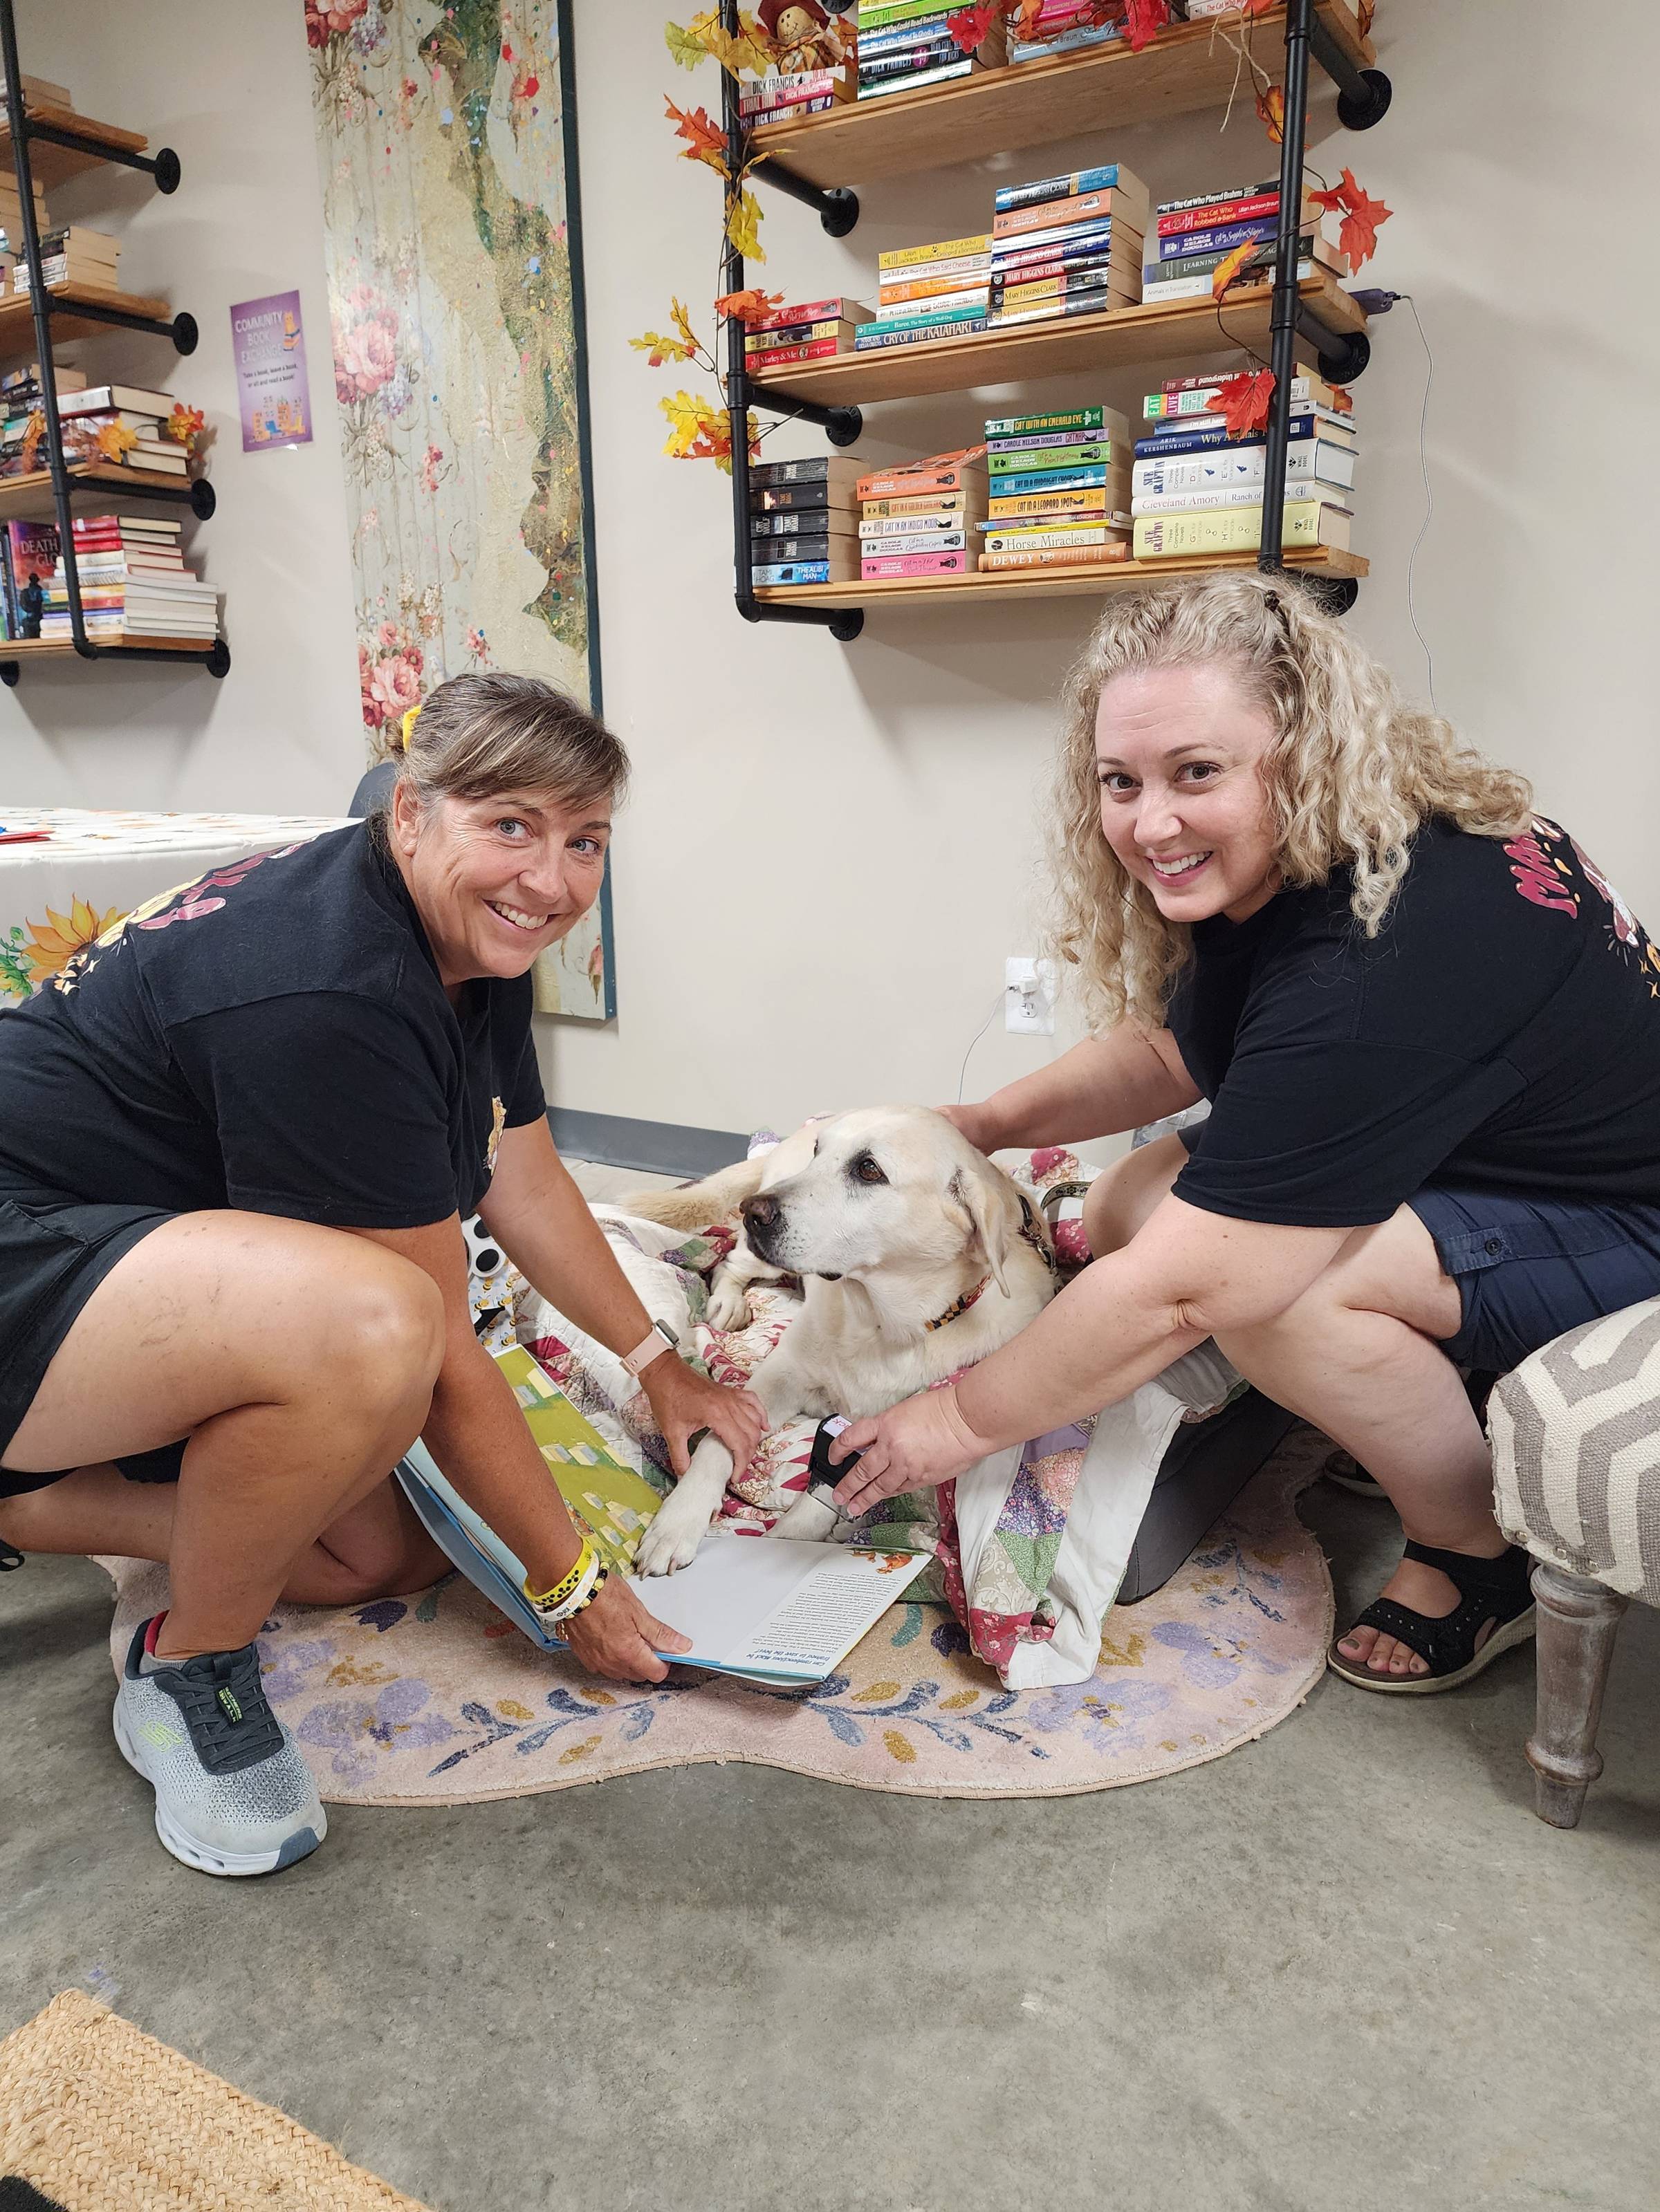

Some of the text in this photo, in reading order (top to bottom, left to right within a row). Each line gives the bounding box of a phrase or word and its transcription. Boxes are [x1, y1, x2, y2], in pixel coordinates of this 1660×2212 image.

[753, 79, 767, 94] DICK
[768, 75, 795, 92] FRANCIS
[743, 95, 761, 113] TRIAL
[755, 108, 793, 127] DICK FRANCIS
[1174, 188, 1243, 210] The Cat Who Played Brahms
[1220, 206, 1233, 214] Who
[1194, 217, 1217, 227] Robbed
[1222, 213, 1237, 221] Bank
[1183, 234, 1211, 242] CAROLE
[1183, 238, 1211, 247] NELSON
[1181, 242, 1213, 252] DOUGLAS
[952, 261, 971, 269] Cheese
[1183, 257, 1218, 272] LEARNING
[1006, 265, 1064, 283] MARY HIGGINS CLARK
[1005, 284, 1058, 300] MARY HIGGINS CLARK
[234, 310, 284, 333] COMMUNITY
[247, 331, 271, 346] BOOK
[883, 322, 972, 345] CRY OF THE KALAHARI
[761, 351, 796, 364] Marley & Me
[1198, 373, 1233, 386] Underground
[1148, 396, 1161, 415] EAT
[1167, 393, 1178, 413] LIVE
[1015, 413, 1082, 431] CAT WITH AN EMERALD EYE
[1004, 432, 1085, 448] CAROLE NELSON DOUGLAS CATNAP
[1201, 434, 1221, 445] Why
[1143, 442, 1192, 453] KERSHENBAUM
[1143, 471, 1154, 486] SUE
[1017, 496, 1073, 512] CAT IN A LEOPARD SPOT
[1142, 492, 1262, 510] Cleveland Amory Ranch of
[762, 517, 771, 535] WOLF
[885, 518, 937, 532] CAT IN AN INDIGO MOOD
[1006, 535, 1085, 550] Horse Miracles
[1145, 530, 1154, 545] SUE
[1153, 521, 1164, 552] GRAFTON
[21, 538, 59, 555] DEATH
[992, 554, 1035, 566] DEWEY
[809, 565, 824, 573] ALIBI
[771, 1656, 813, 1664] rambunctious
